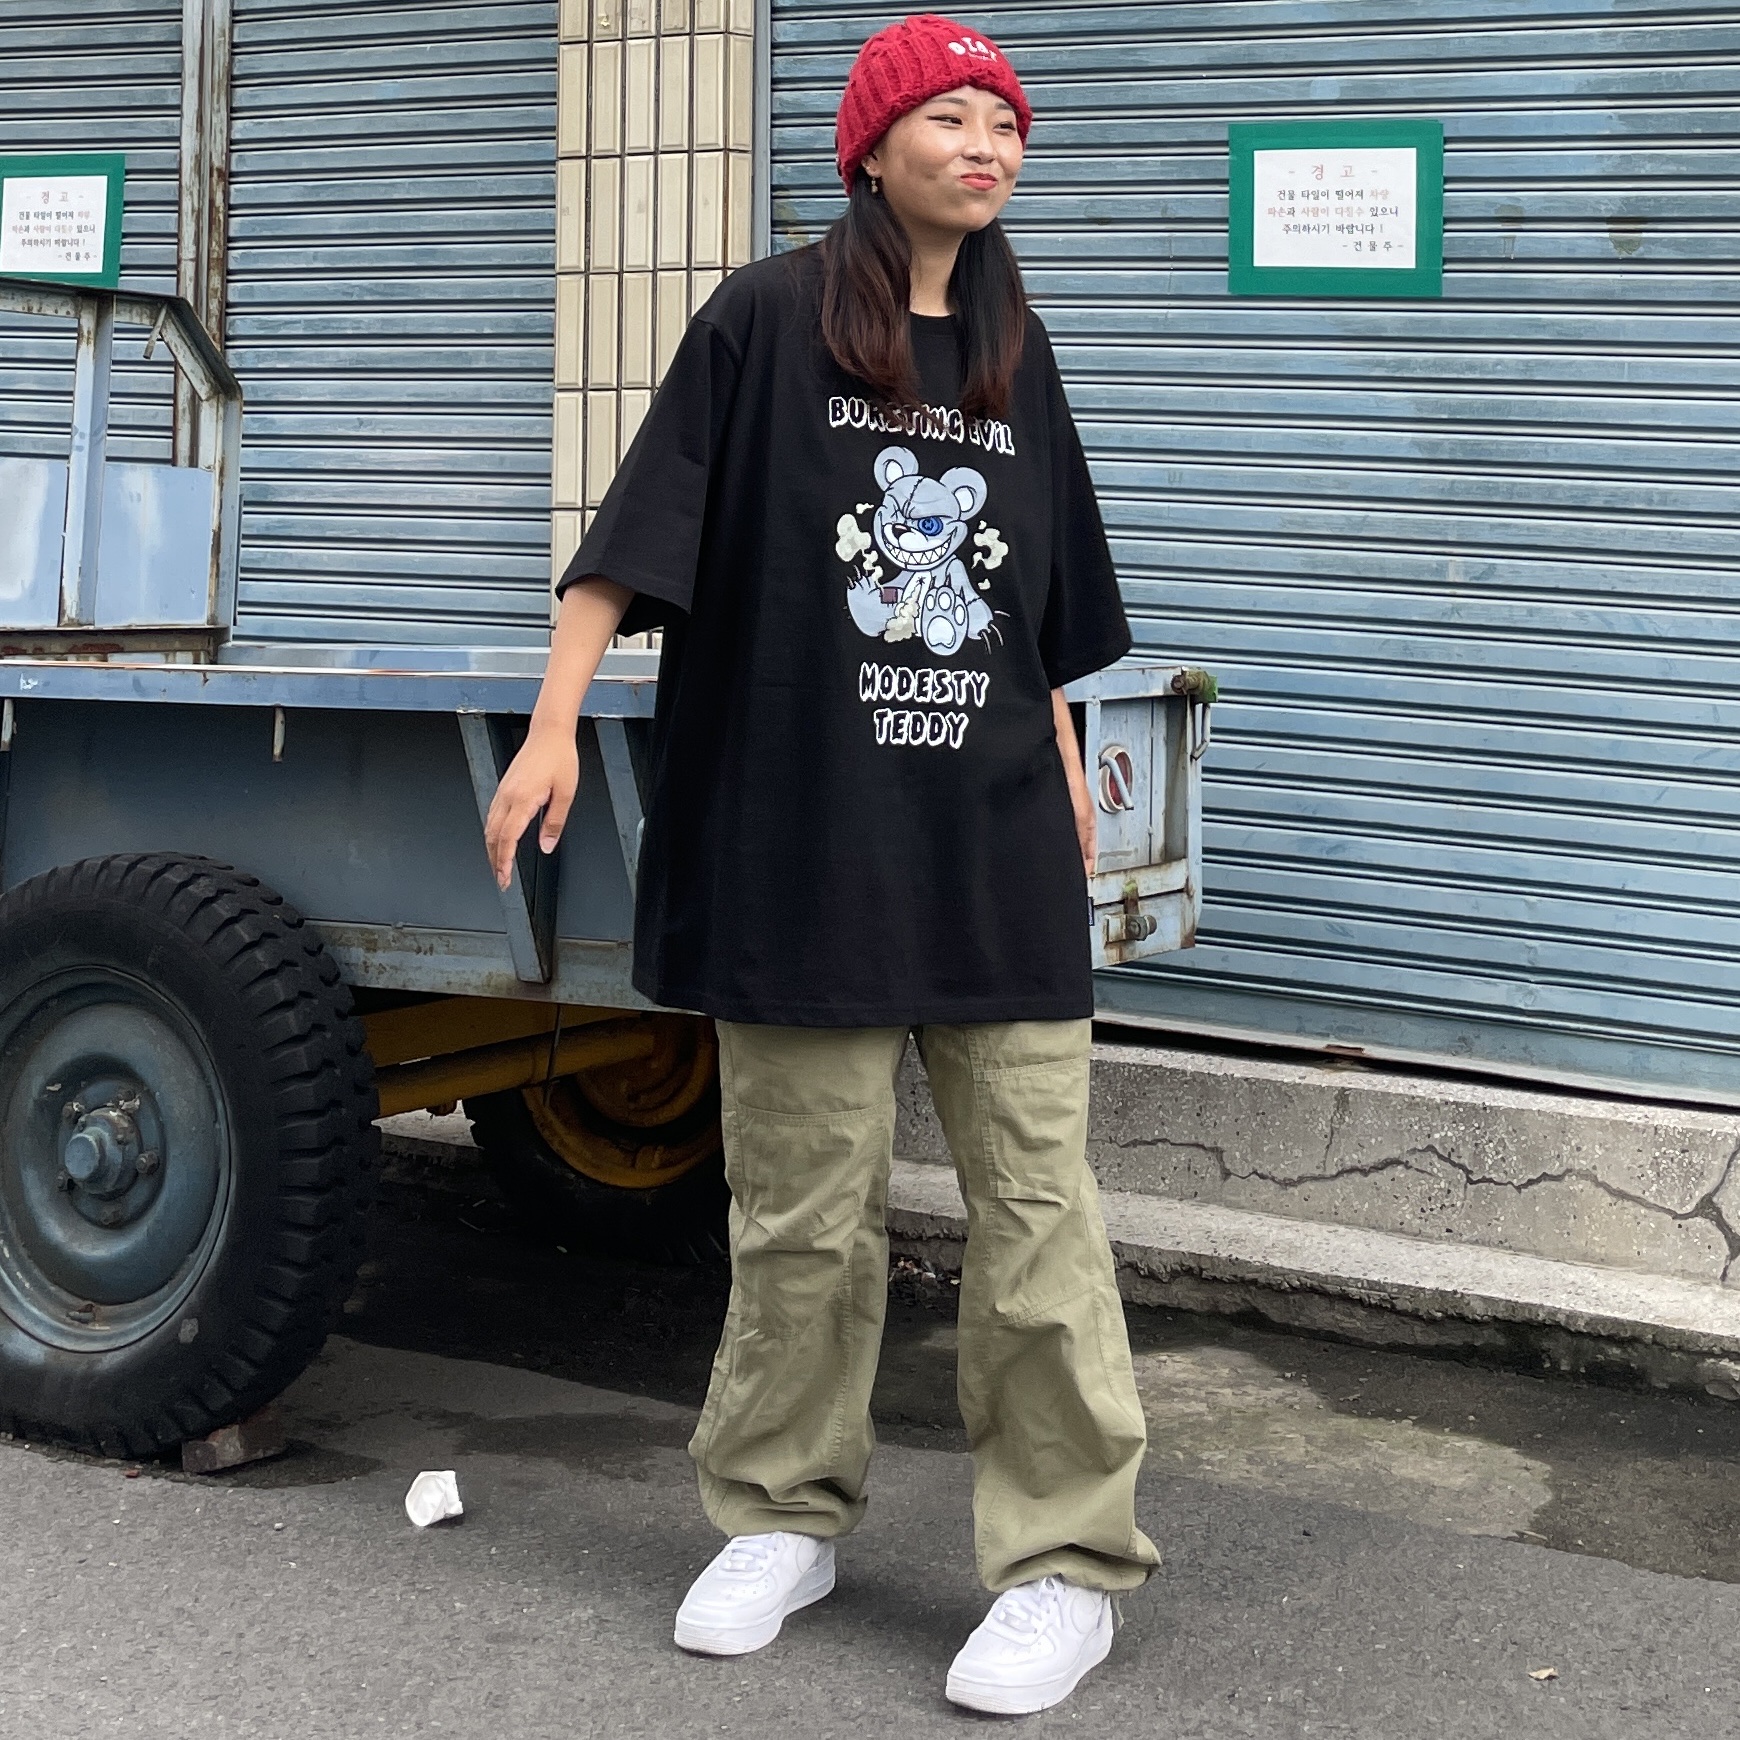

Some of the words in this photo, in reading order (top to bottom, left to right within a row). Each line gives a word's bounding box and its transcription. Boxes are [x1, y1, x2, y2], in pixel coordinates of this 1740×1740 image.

[1277, 190, 1295, 200] 건물
[1301, 190, 1330, 200] 타일이
[1369, 207, 1399, 217] 있으니
[1282, 223, 1330, 234] 주의하시기
[859, 662, 990, 708] MODESTY
[873, 708, 969, 749] TEDDY
